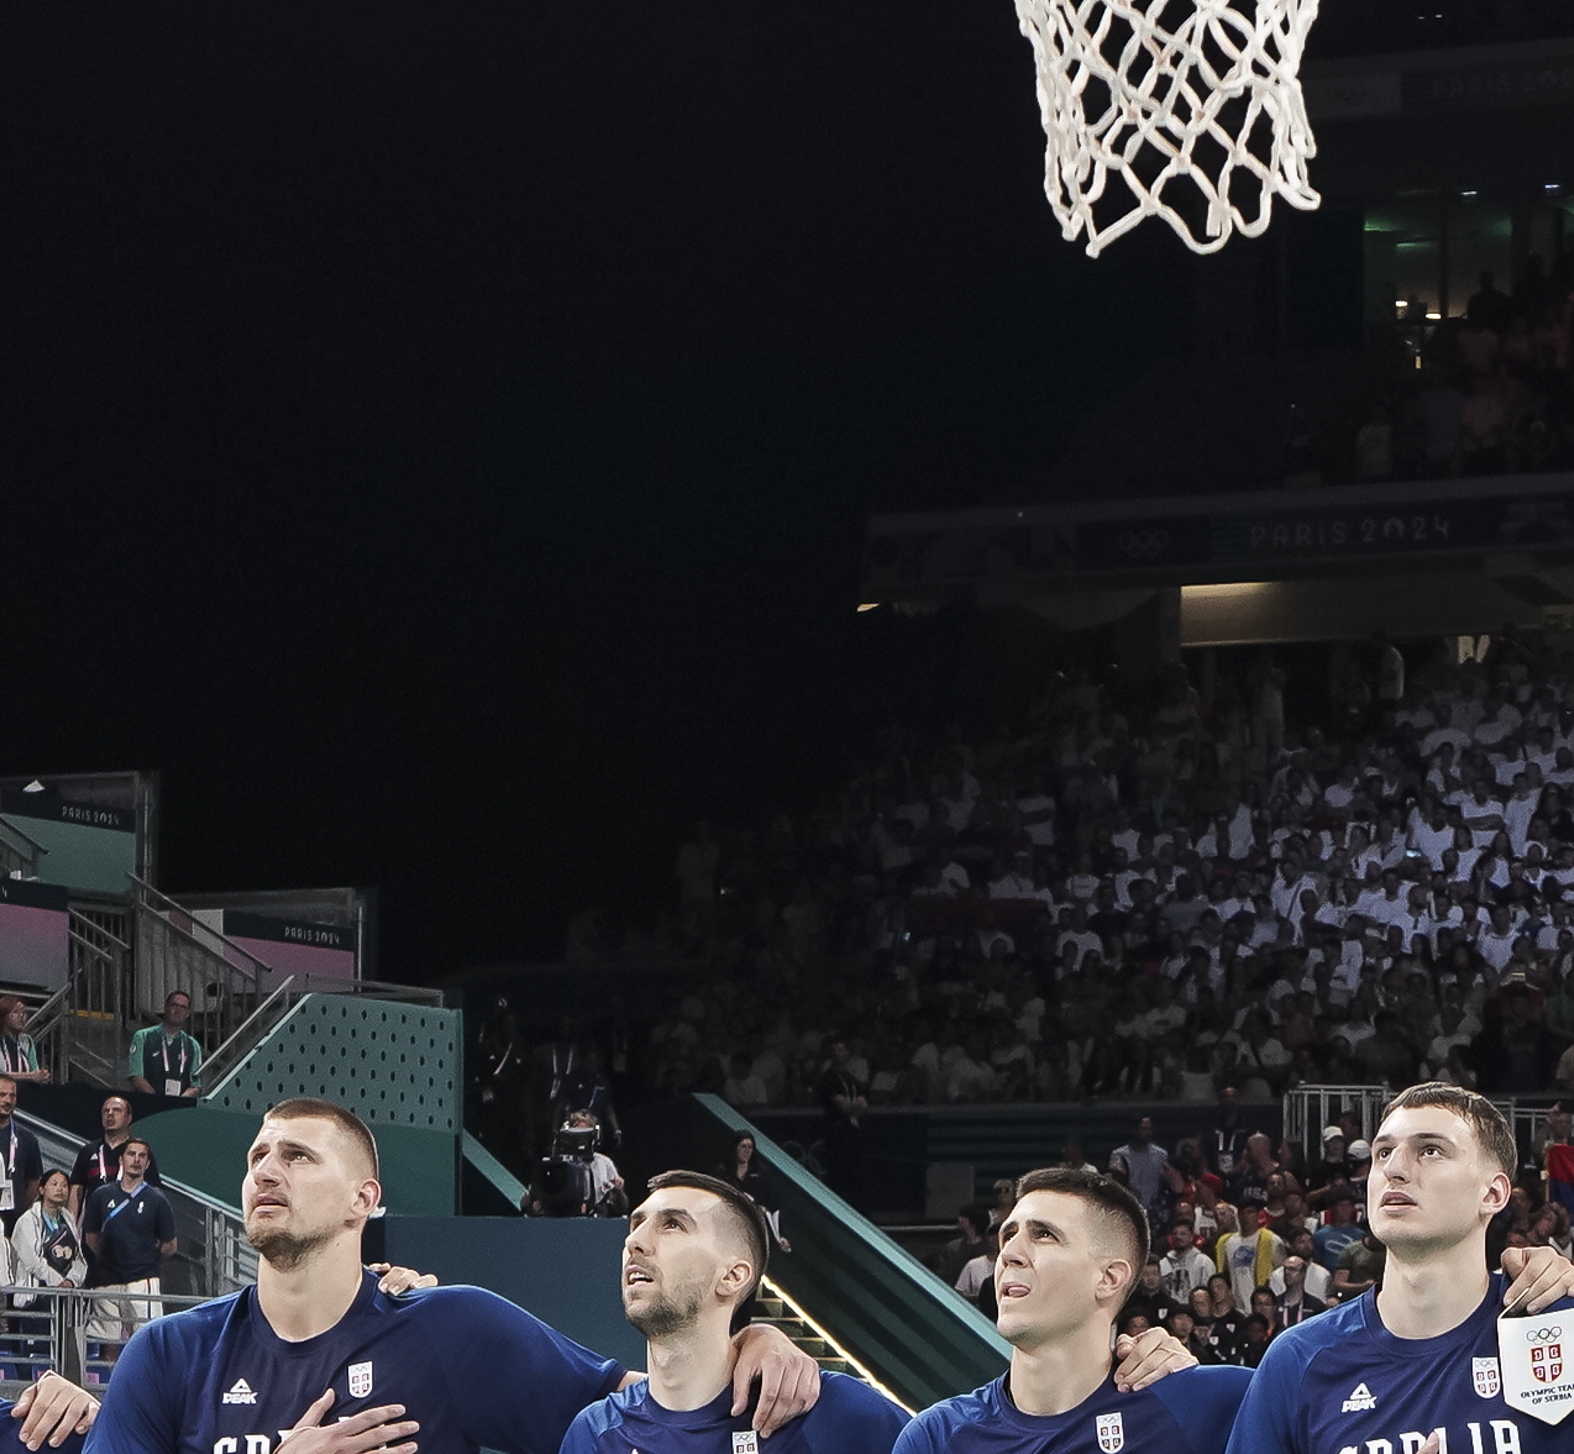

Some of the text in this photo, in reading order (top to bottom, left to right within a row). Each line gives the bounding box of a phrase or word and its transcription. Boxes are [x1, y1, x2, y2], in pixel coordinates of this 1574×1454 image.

[1251, 516, 1450, 550] PARIS 2024
[62, 805, 120, 826] PARIS 2024
[284, 926, 340, 945] PARIS 2024
[1520, 1386, 1557, 1400] OLYMPIC
[1532, 1392, 1572, 1406] OF SERBIA
